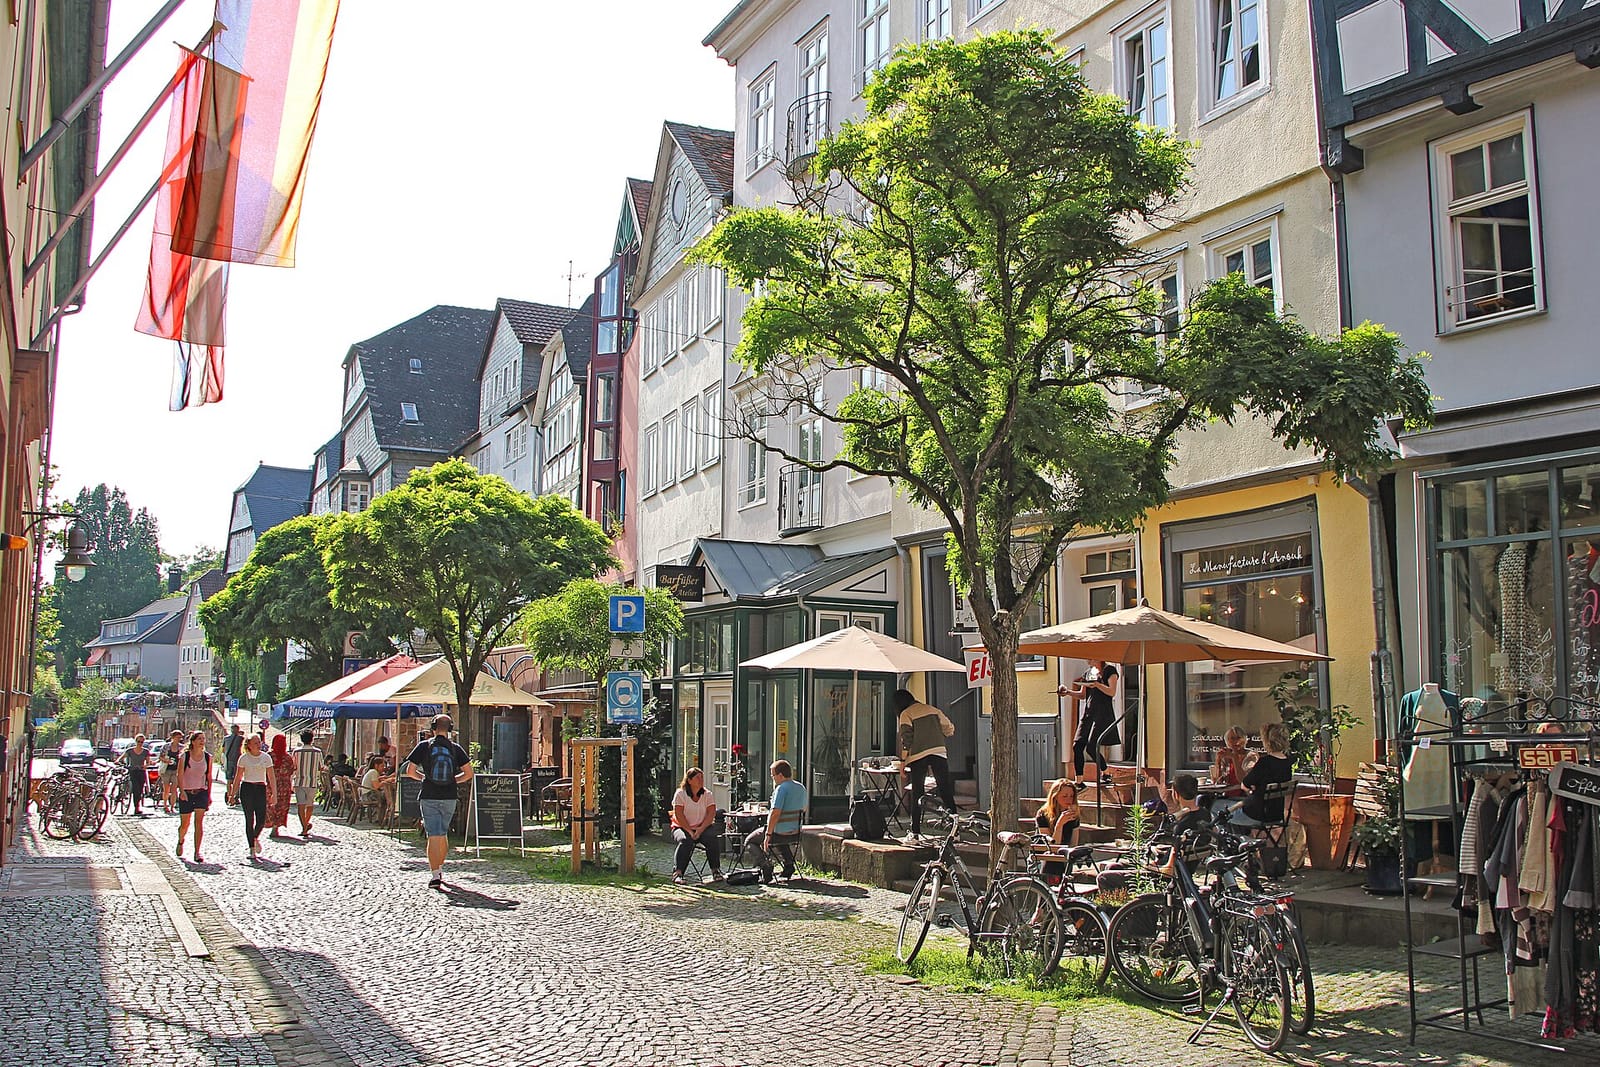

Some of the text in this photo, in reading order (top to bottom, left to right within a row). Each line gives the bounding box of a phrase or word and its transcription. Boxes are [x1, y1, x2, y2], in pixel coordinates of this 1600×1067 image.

[1189, 562, 1201, 574] La
[1203, 554, 1260, 574] Manufacture
[660, 573, 699, 592] Barfüßer
[675, 589, 698, 597] Atelier
[617, 600, 636, 628] P
[1524, 750, 1573, 765] SALE
